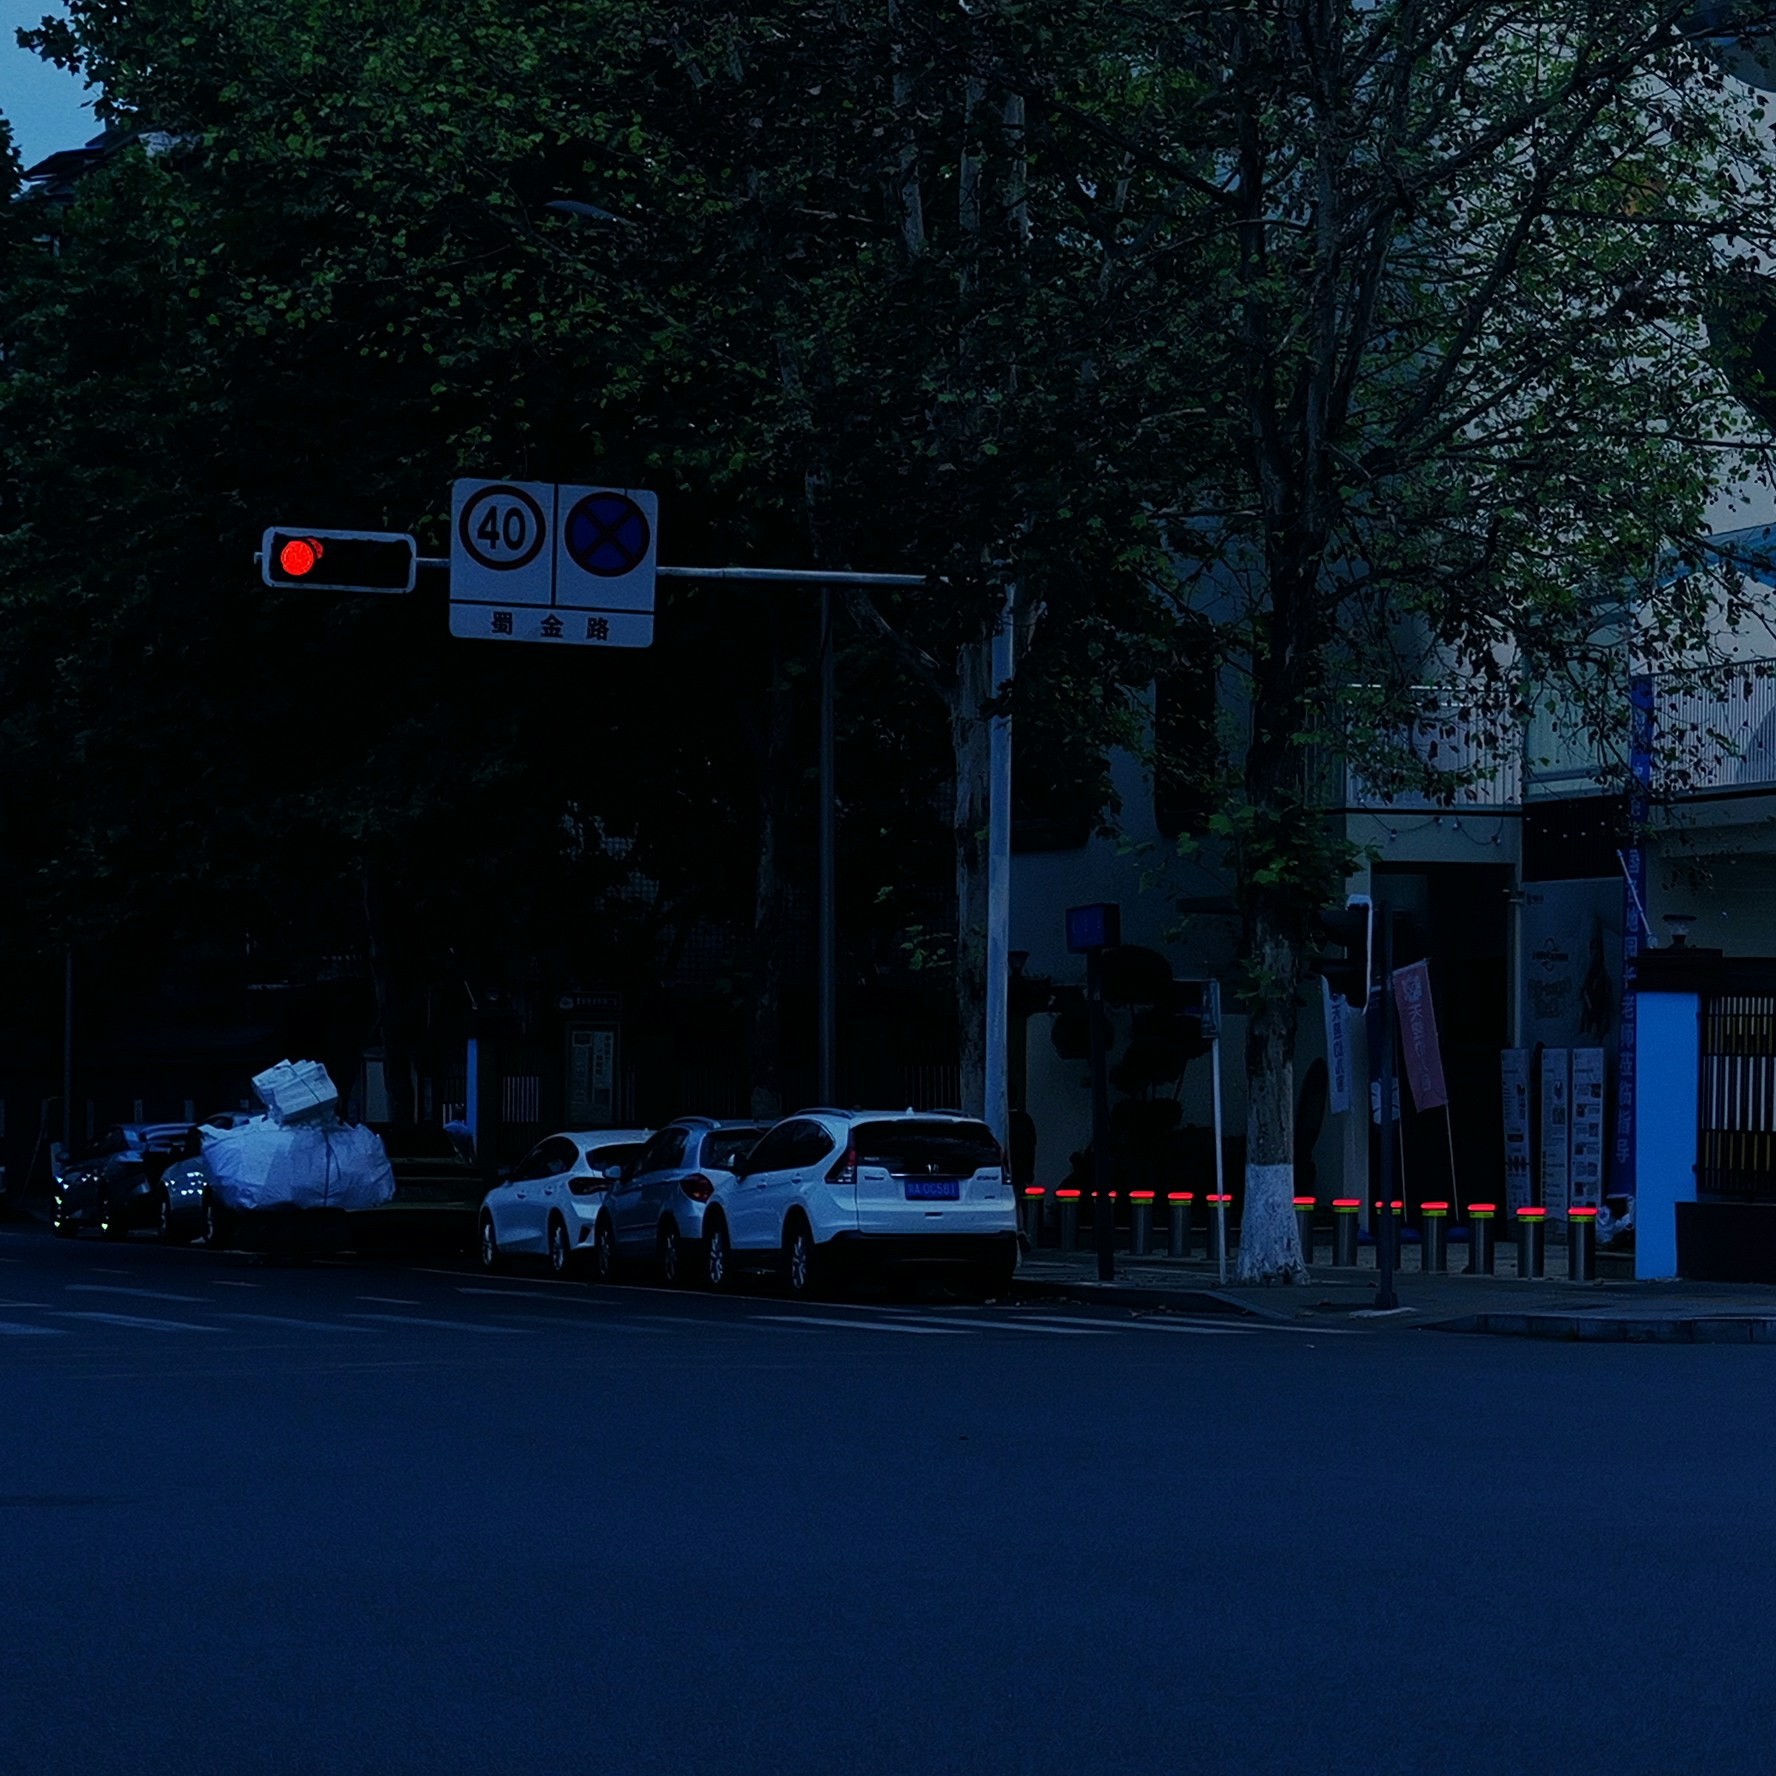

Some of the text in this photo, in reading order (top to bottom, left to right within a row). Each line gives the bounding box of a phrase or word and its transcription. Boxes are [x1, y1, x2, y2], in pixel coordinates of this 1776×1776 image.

[477, 506, 526, 551] 40
[492, 611, 610, 641] 蜀金路
